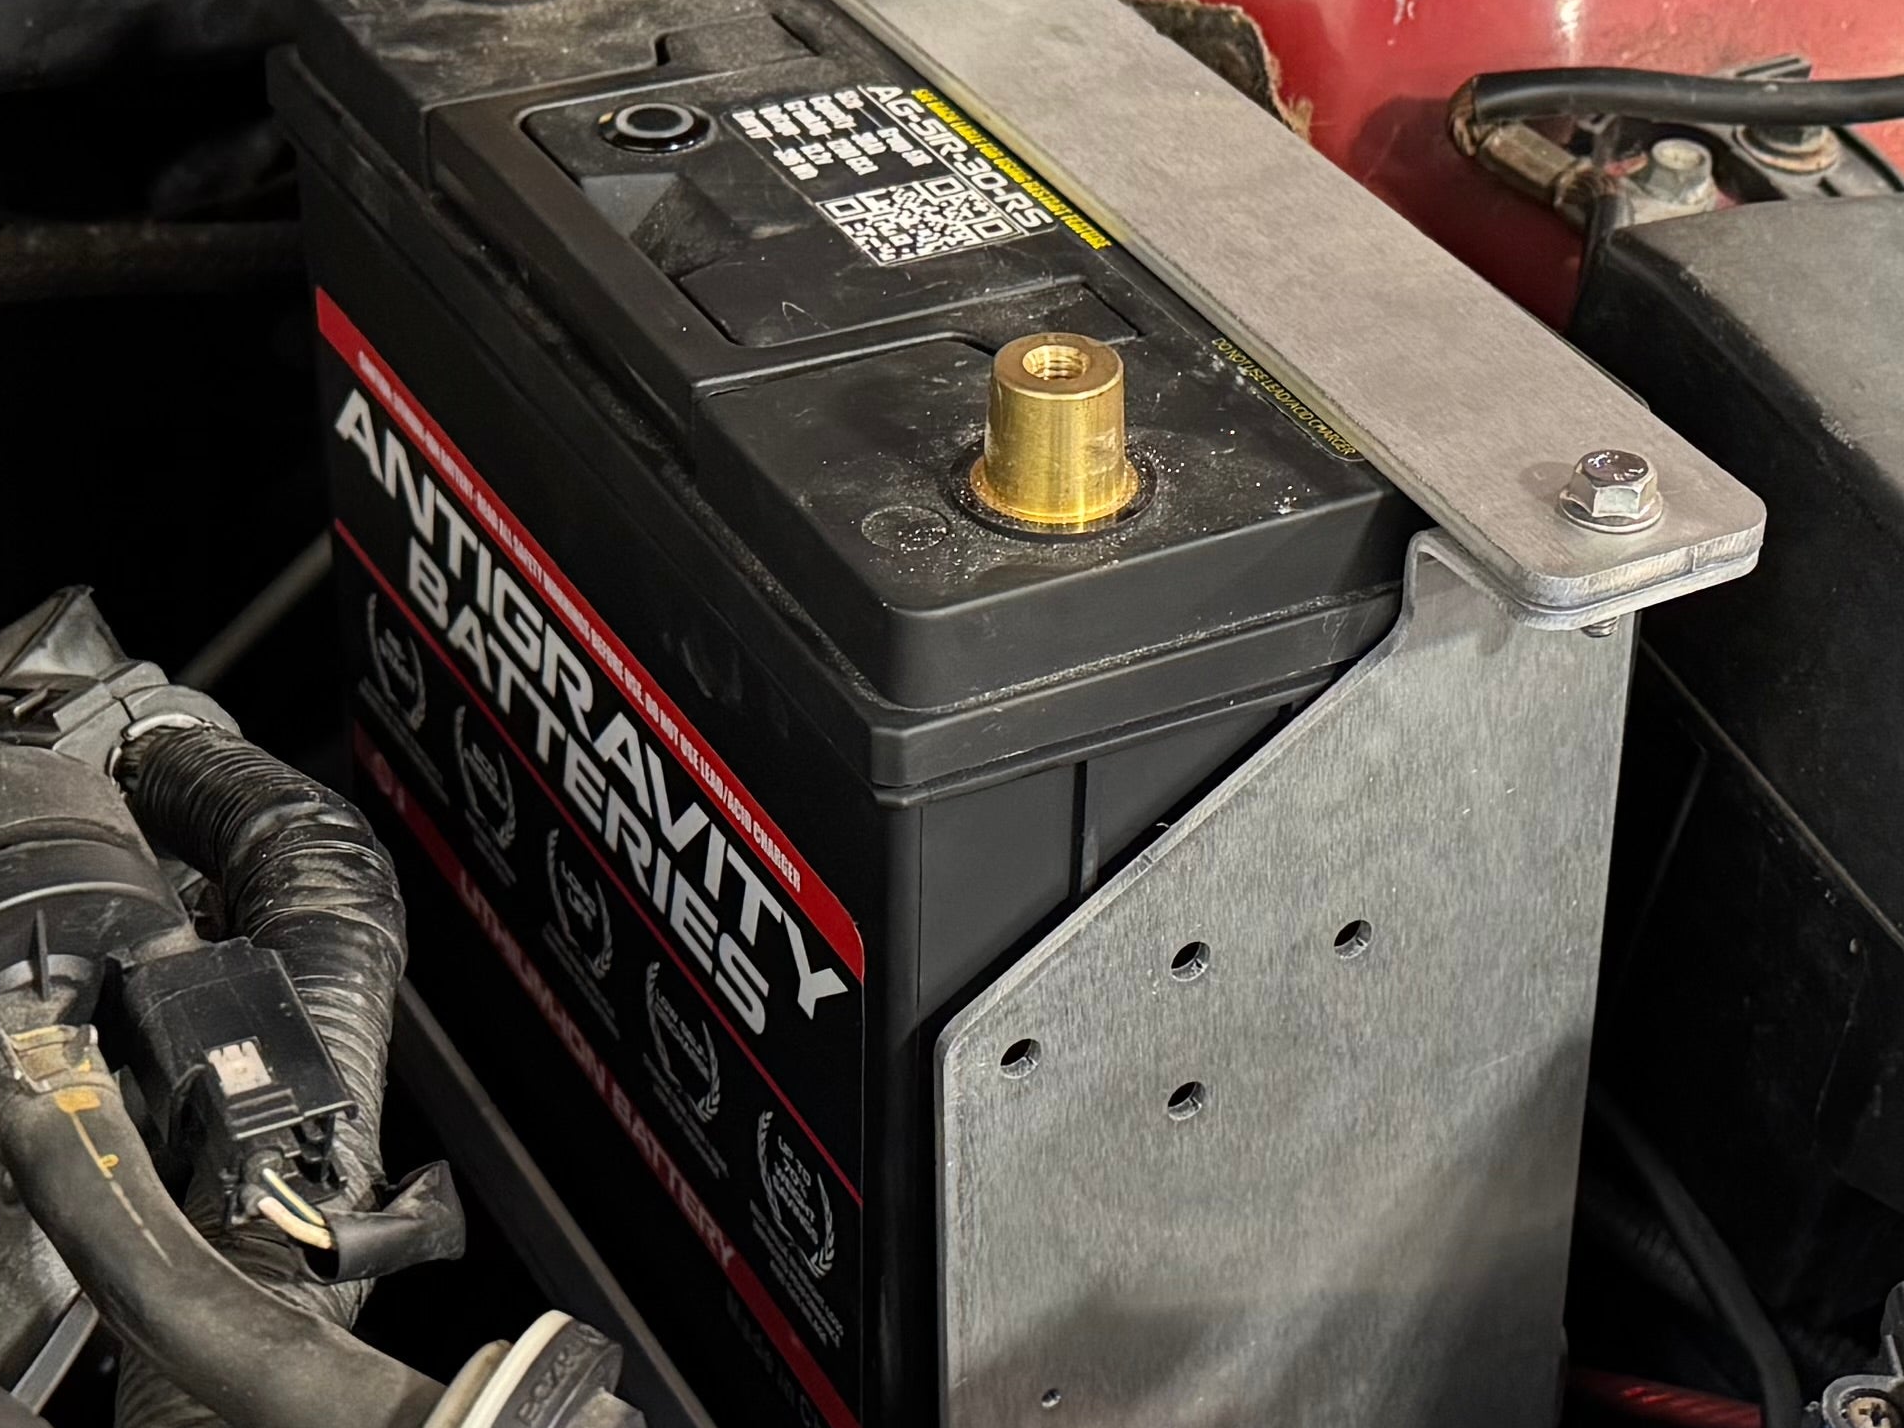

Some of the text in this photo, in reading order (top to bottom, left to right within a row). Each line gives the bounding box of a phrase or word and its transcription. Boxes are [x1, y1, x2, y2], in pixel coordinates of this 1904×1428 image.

[335, 389, 848, 1019] ANTIGRAVITY
[409, 537, 769, 1034] BATTERIES
[700, 757, 751, 833] LEAD/ACID
[753, 821, 800, 892] CHARGER
[613, 1084, 734, 1267] BATTERY
[796, 1159, 811, 1186] TO
